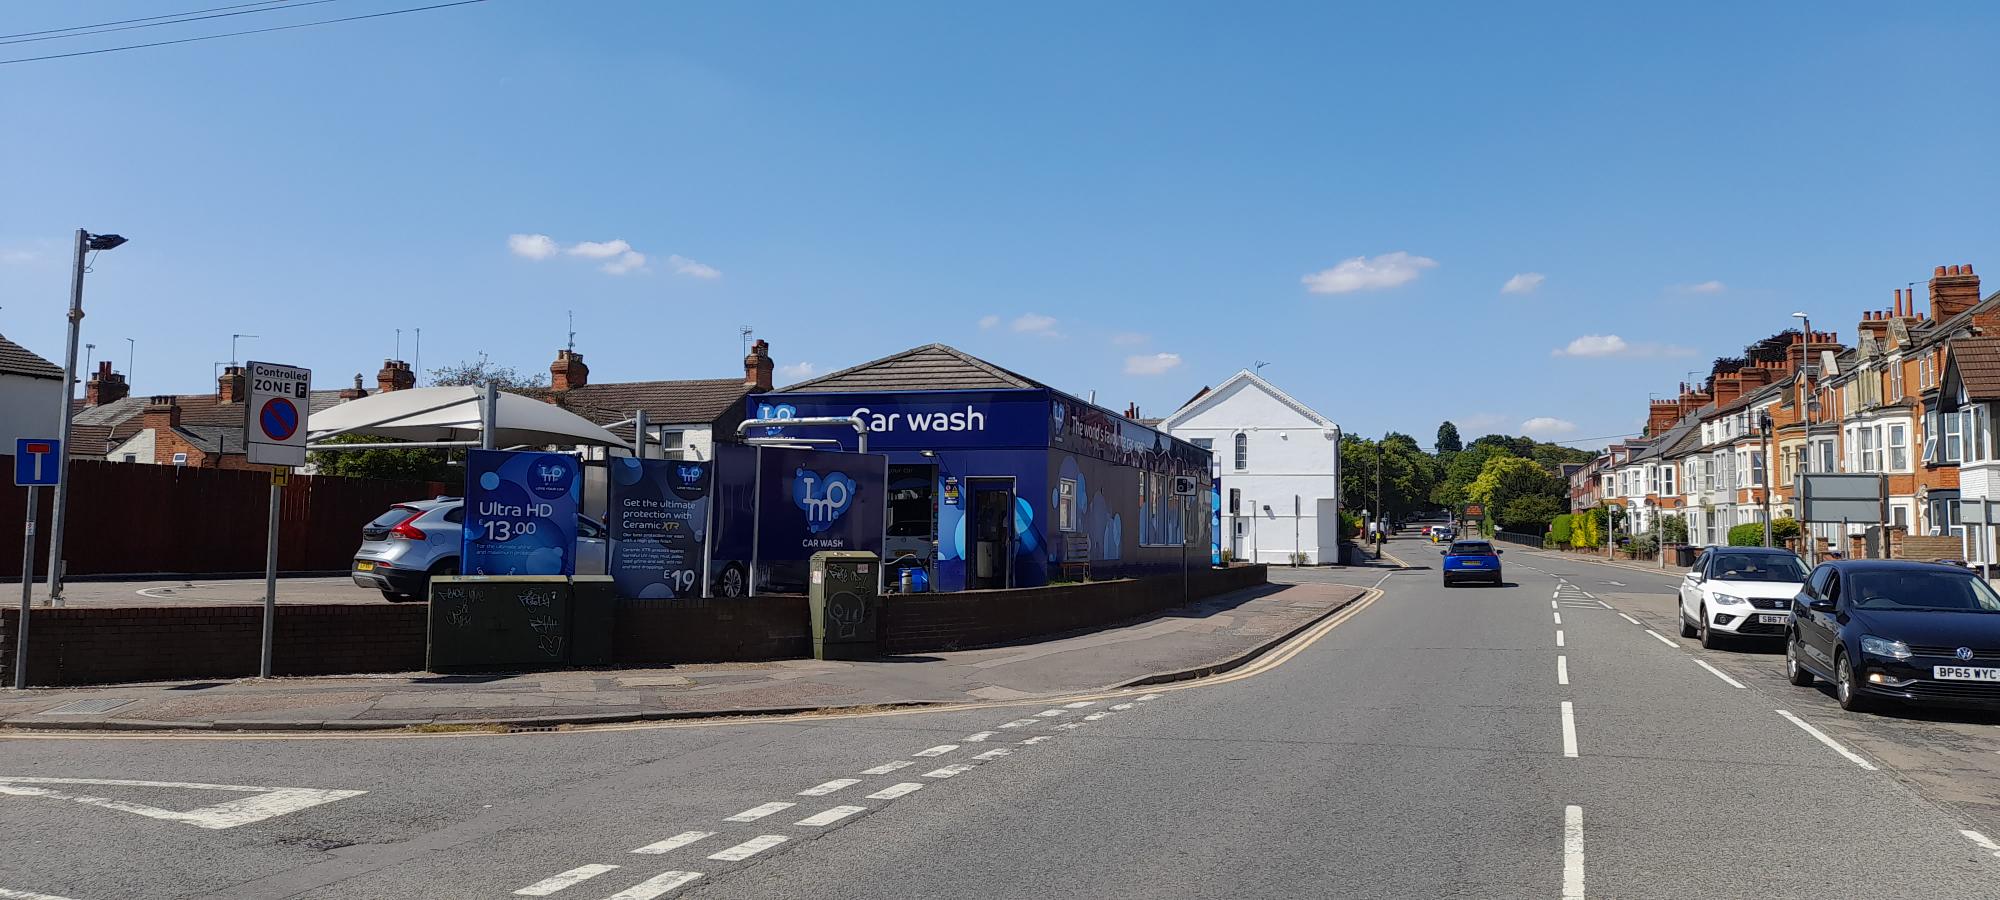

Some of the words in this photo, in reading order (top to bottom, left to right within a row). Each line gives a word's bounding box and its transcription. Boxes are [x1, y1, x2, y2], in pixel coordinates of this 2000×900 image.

[256, 366, 308, 381] Controlled
[254, 379, 291, 394] ZONE
[297, 384, 305, 397] F
[852, 408, 900, 432] Car
[906, 405, 984, 431] wash
[1071, 415, 1083, 436] The
[273, 467, 287, 484] H
[479, 501, 522, 517] Ultra
[526, 503, 553, 517] HD
[623, 498, 641, 507] Get
[642, 499, 658, 508] the
[660, 500, 696, 510] ultimate
[623, 510, 672, 520] protection
[673, 511, 692, 520] with
[622, 520, 661, 530] Ceramic
[661, 521, 680, 531] XTR
[802, 539, 818, 547] CAR
[819, 539, 844, 548] WASH
[1762, 615, 1782, 624] SB67
[1939, 667, 1971, 678] BP65
[1973, 668, 1997, 679] WYC
